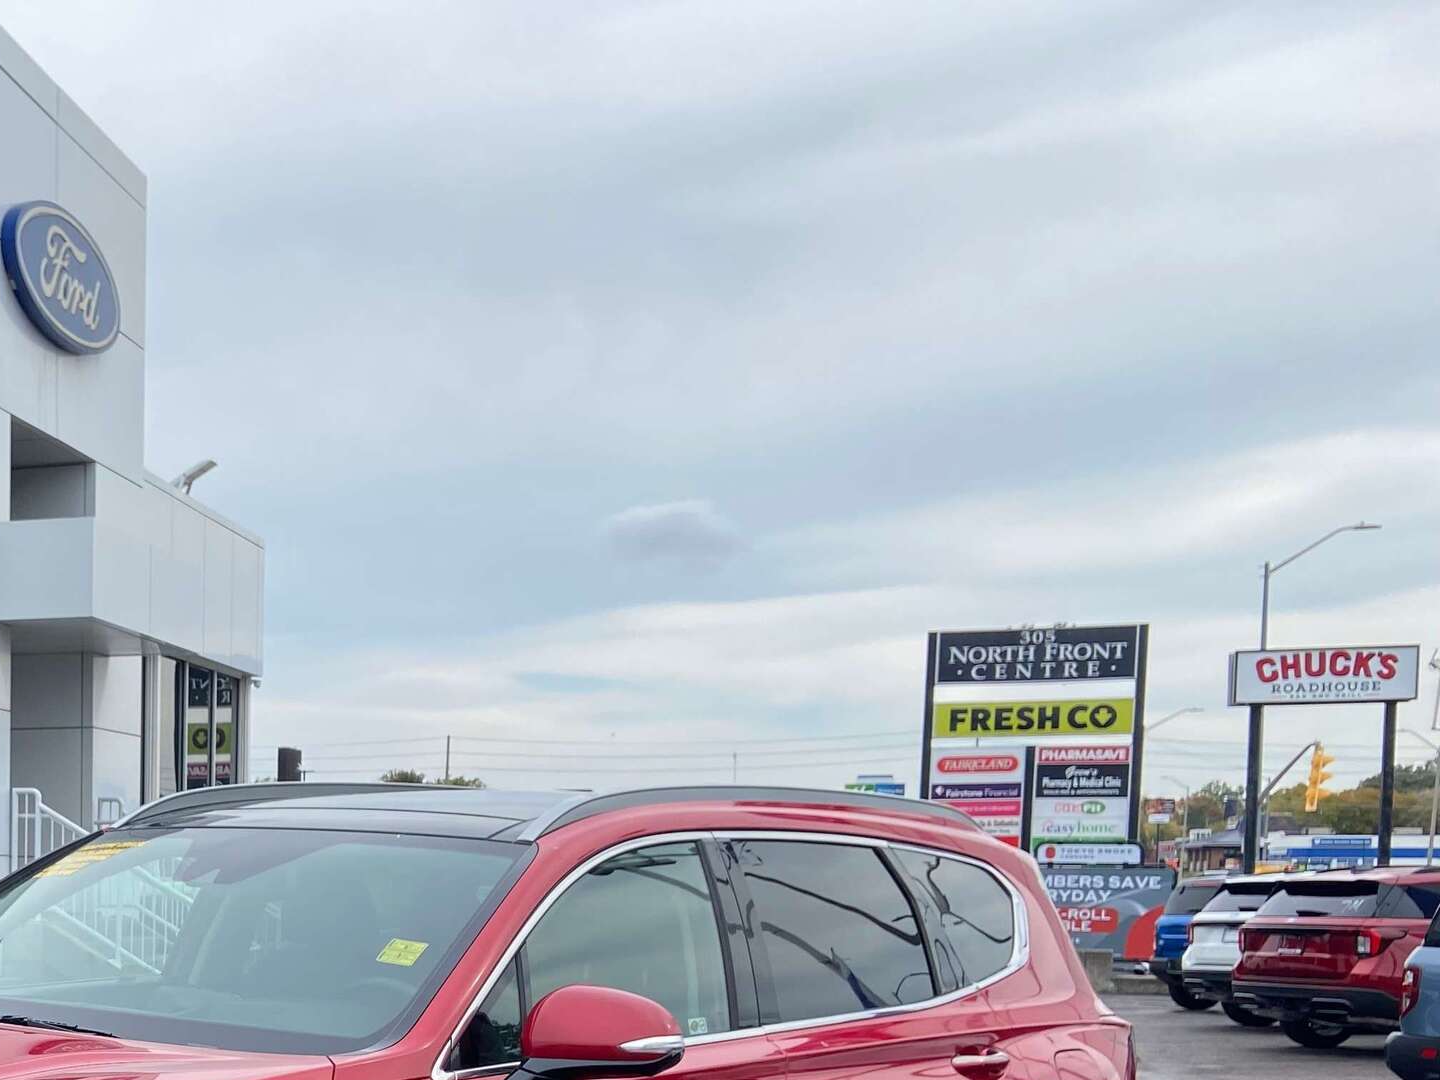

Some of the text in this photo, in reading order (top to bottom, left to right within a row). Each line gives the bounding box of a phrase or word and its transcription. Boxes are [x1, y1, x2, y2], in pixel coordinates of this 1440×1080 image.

[40, 225, 100, 330] Ford
[1020, 629, 1056, 645] 305
[948, 641, 1128, 664] NORTH FRONT
[970, 661, 1101, 681] CENTRE
[1255, 649, 1399, 683] CHUCK'S
[1271, 681, 1381, 694] ROADHOUSE
[1040, 748, 1127, 761] PHARMASAVE
[1045, 874, 1161, 890] MBERS SAVE
[1048, 889, 1112, 902] RYDAY
[1057, 908, 1111, 920] -ROLL
